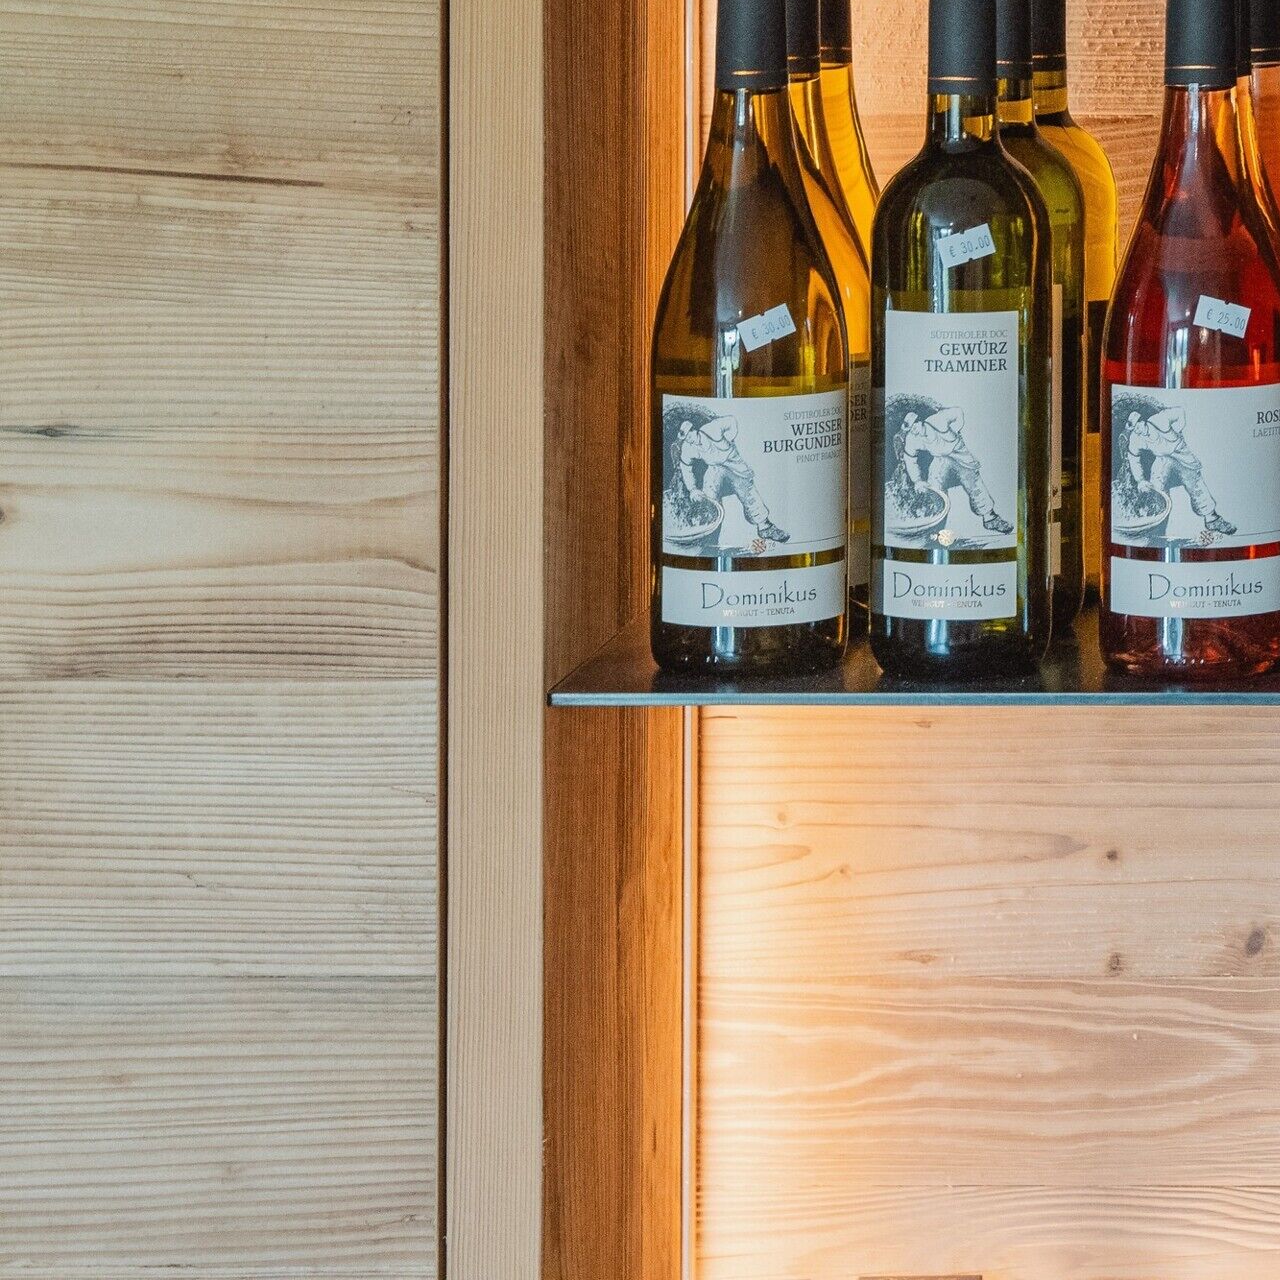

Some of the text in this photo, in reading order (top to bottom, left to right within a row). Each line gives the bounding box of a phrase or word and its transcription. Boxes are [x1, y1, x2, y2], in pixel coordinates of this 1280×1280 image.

[960, 235, 990, 254] 30.00
[764, 315, 791, 335] 30.00
[1217, 312, 1246, 331] 25.00
[930, 329, 1008, 339] SÜDTIROLER DOC
[940, 340, 1007, 356] GEWÜRZ
[924, 358, 1007, 372] TRAMINER
[784, 409, 830, 420] SÜDTIROLER
[791, 418, 842, 436] WEISSER
[763, 433, 842, 453] BURGUNDER
[893, 571, 1006, 598] Dominikus
[1149, 572, 1263, 600] Dominikus
[701, 580, 817, 609] Dominikus
